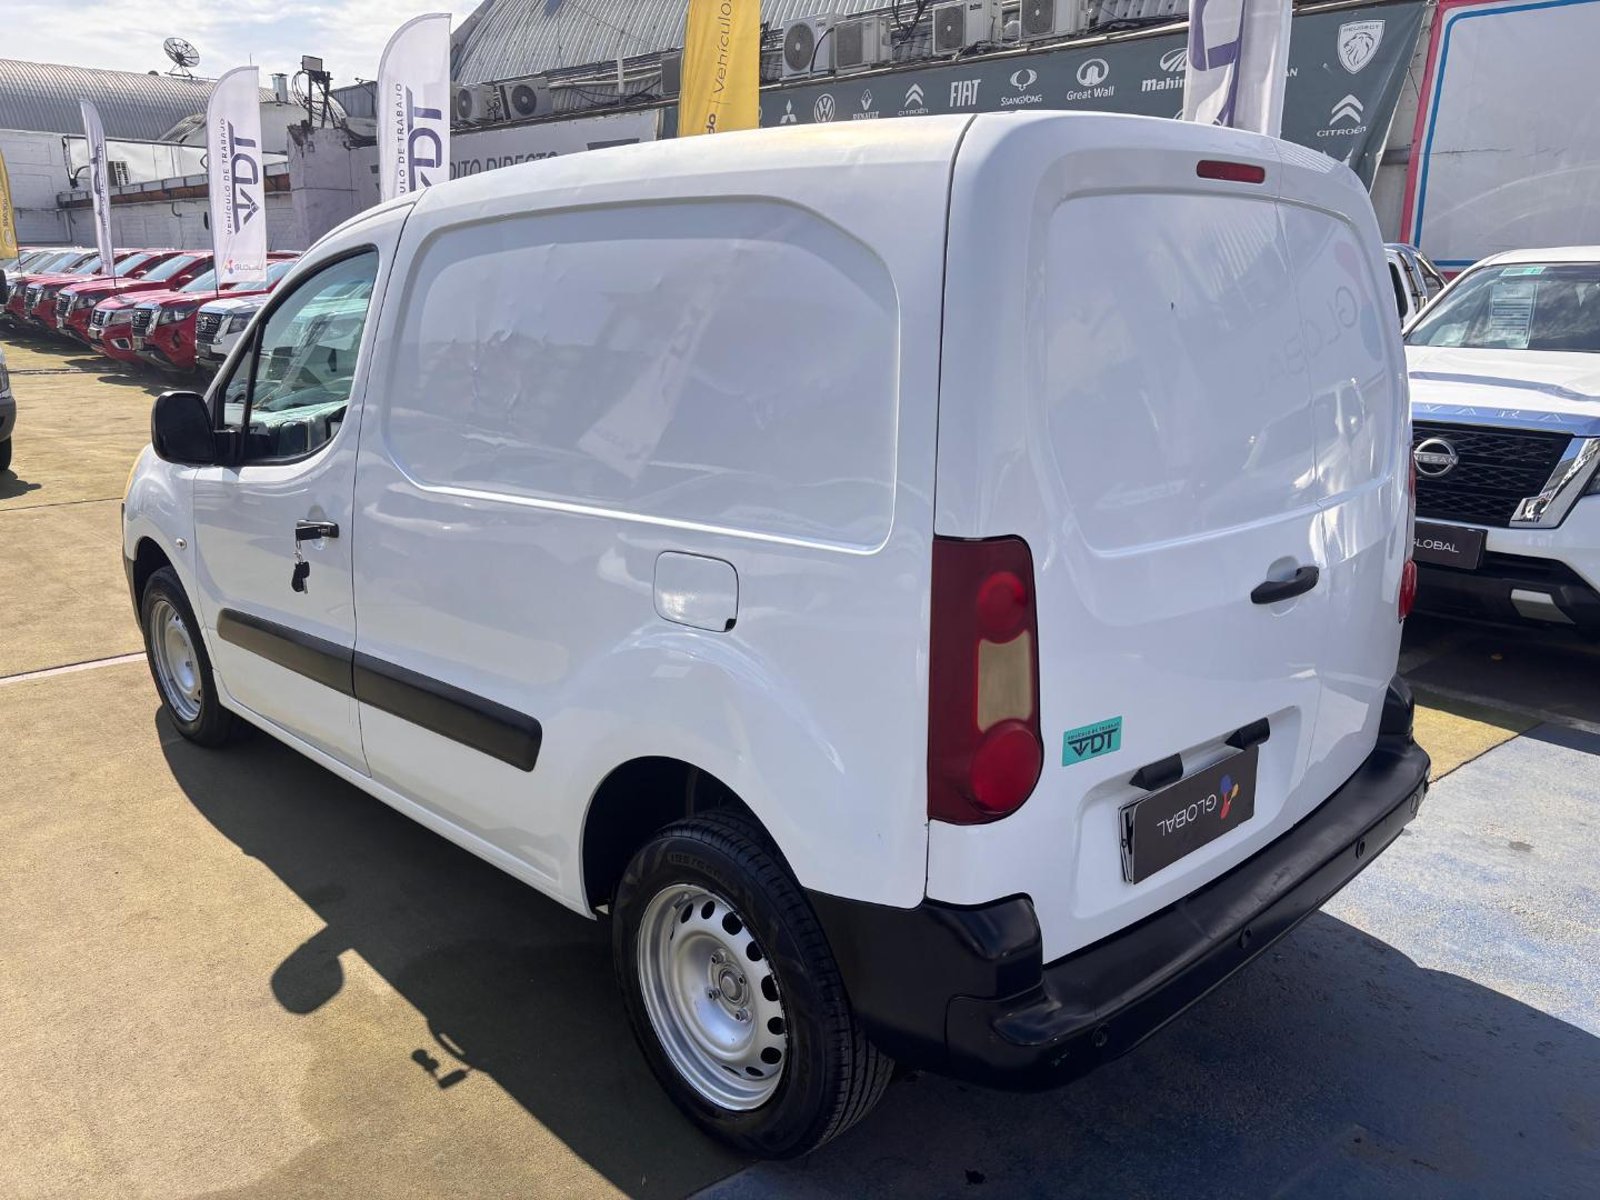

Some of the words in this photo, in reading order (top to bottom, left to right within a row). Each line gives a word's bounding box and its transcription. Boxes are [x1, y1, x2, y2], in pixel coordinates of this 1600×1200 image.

[949, 79, 982, 107] FIAT
[1066, 89, 1091, 101] Great
[1094, 86, 1115, 98] Wall
[1141, 76, 1185, 92] Mahin
[395, 83, 405, 143] TRABAJO
[219, 118, 228, 164] TRABAJO
[397, 147, 405, 164] DE
[223, 169, 230, 181] DE
[450, 159, 482, 181] DITO
[1423, 403, 1563, 422] VARA
[1413, 453, 1459, 465] NISSAN
[1156, 793, 1217, 837] GLOBAL
